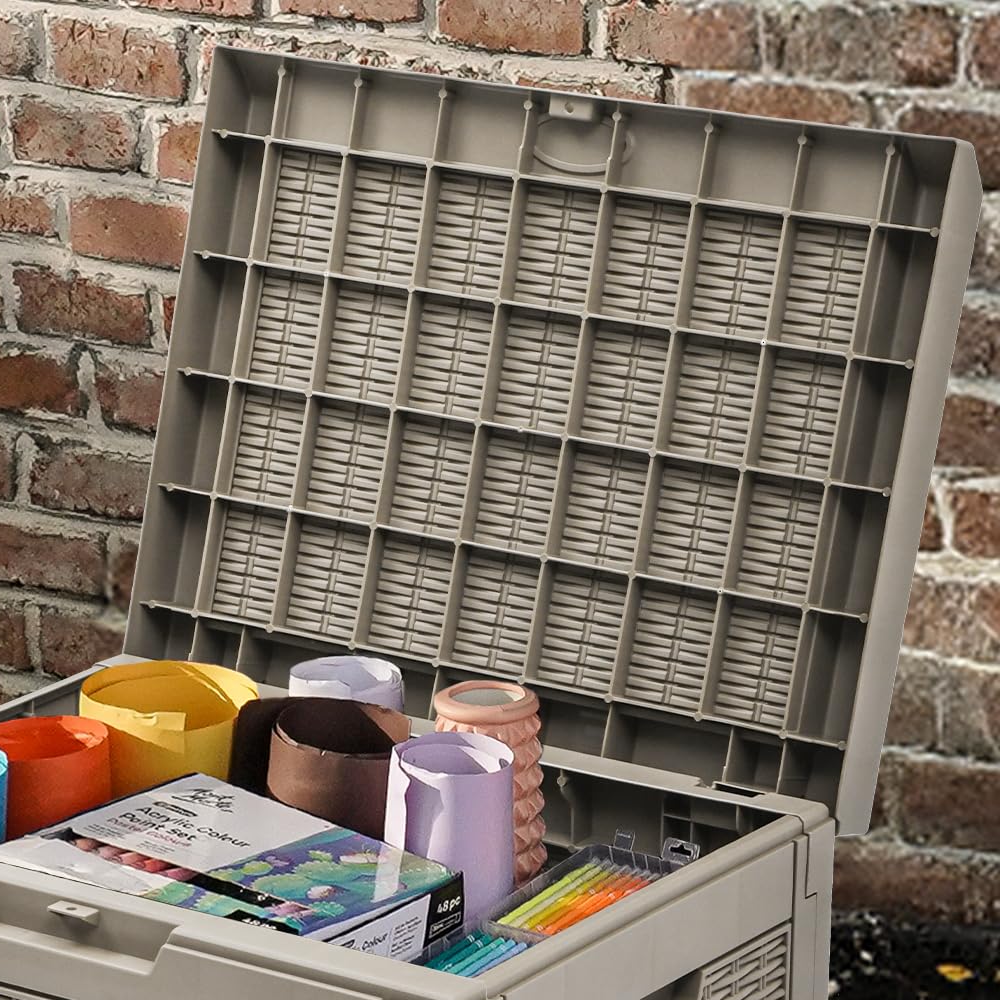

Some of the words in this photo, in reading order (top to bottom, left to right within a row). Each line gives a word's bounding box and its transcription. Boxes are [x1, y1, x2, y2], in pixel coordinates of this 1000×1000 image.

[119, 812, 165, 830] Paint
[165, 828, 197, 841] Set
[136, 806, 195, 829] Acrylic
[197, 827, 251, 847] Colour
